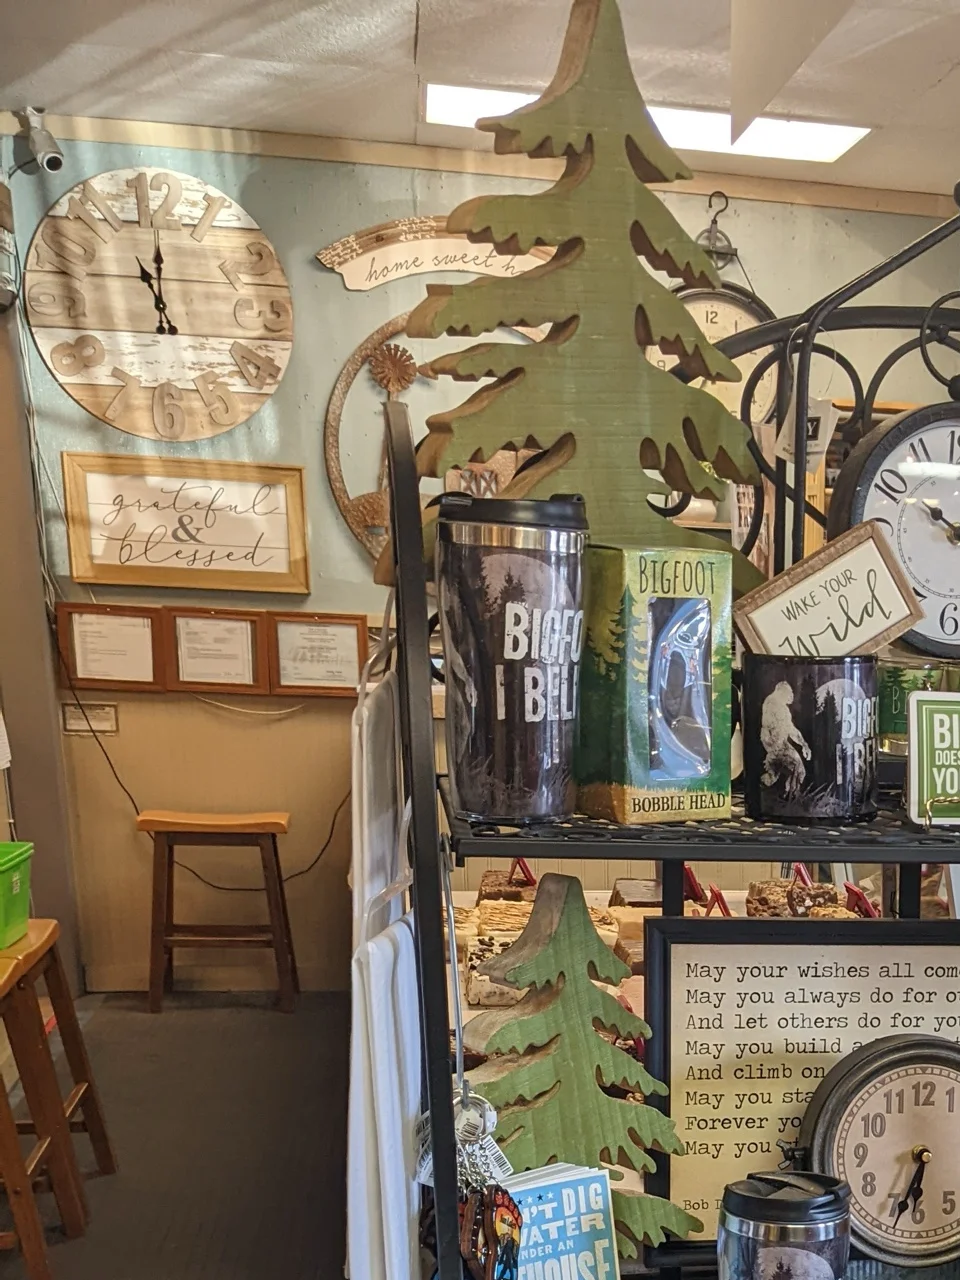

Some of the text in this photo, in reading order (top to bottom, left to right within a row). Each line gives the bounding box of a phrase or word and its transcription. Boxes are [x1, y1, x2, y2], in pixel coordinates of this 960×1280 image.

[126, 173, 182, 230] 12
[365, 257, 424, 282] home
[432, 250, 497, 267] sweet
[706, 311, 718, 324] 12
[51, 334, 105, 377] 8
[99, 481, 281, 528] grateful
[171, 515, 206, 543] &
[99, 524, 274, 569] blessed
[639, 556, 716, 595] BIGFOOT
[781, 568, 857, 623] WAKE YOUR
[779, 569, 892, 656] wild
[939, 603, 959, 636] 6
[631, 793, 726, 813] BOBBLE HEAD
[686, 962, 726, 981] May
[736, 965, 787, 982] your
[798, 962, 870, 978] wishes
[879, 963, 914, 978] all
[785, 1038, 842, 1054] build
[912, 1081, 936, 1106] 12
[685, 1115, 768, 1130] Forever
[561, 1182, 603, 1217] DIG
[683, 1199, 709, 1211] Bob
[557, 1238, 574, 1252] AN
